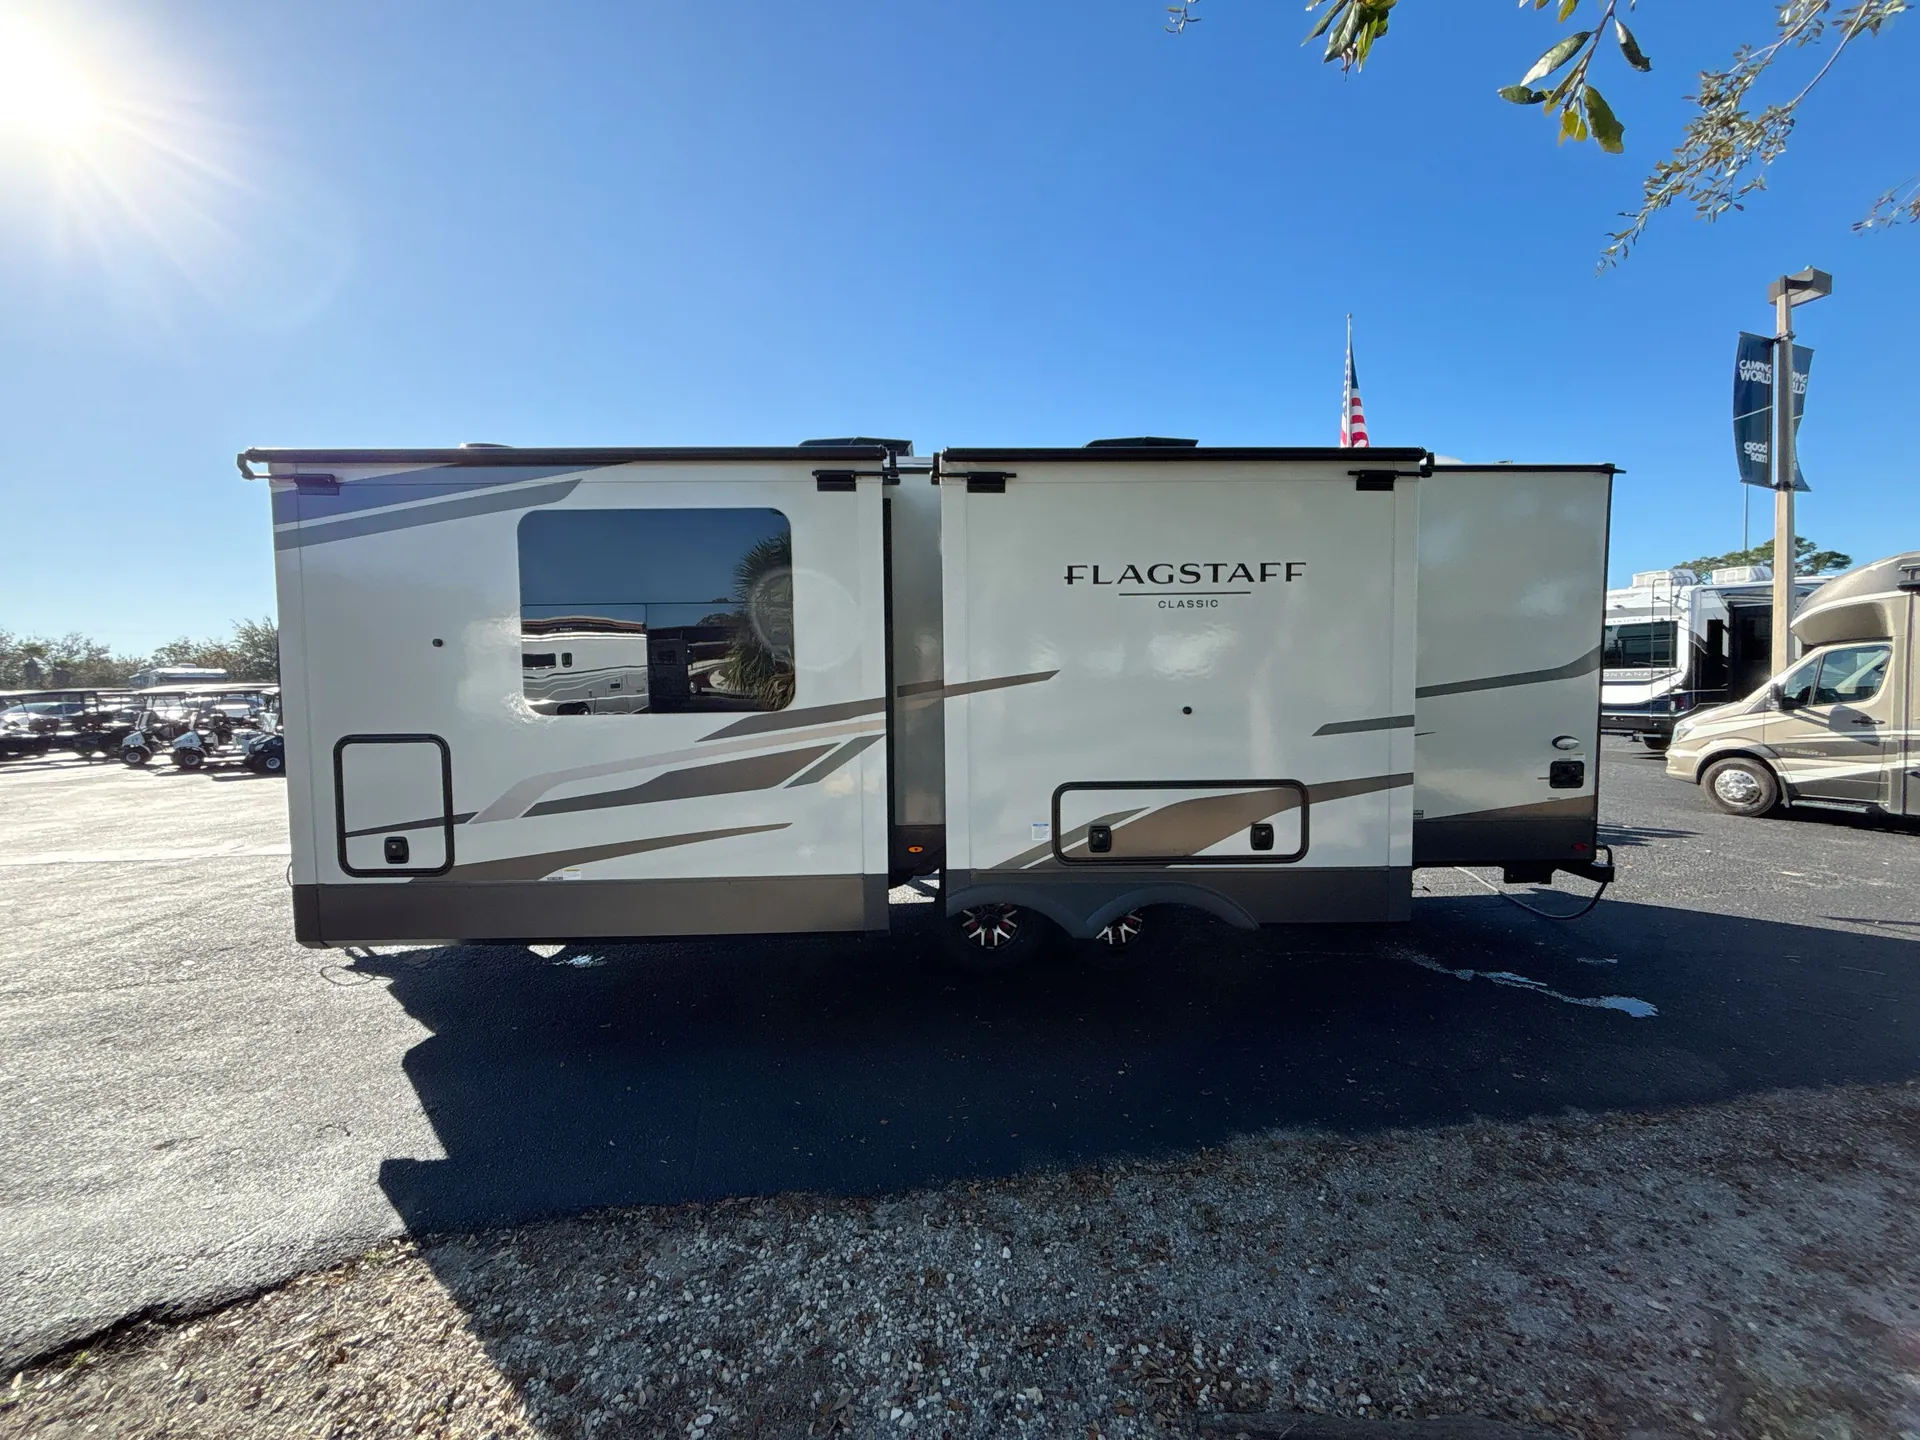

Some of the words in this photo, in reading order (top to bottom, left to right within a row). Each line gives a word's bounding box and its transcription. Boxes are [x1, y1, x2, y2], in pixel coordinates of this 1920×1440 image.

[1739, 360, 1772, 373] CAMPING
[1739, 370, 1772, 384] WORLD
[1744, 441, 1768, 455] good
[1750, 452, 1768, 463] sam
[1064, 562, 1307, 585] FLAGSTAFF
[1158, 599, 1219, 609] CLASSIC
